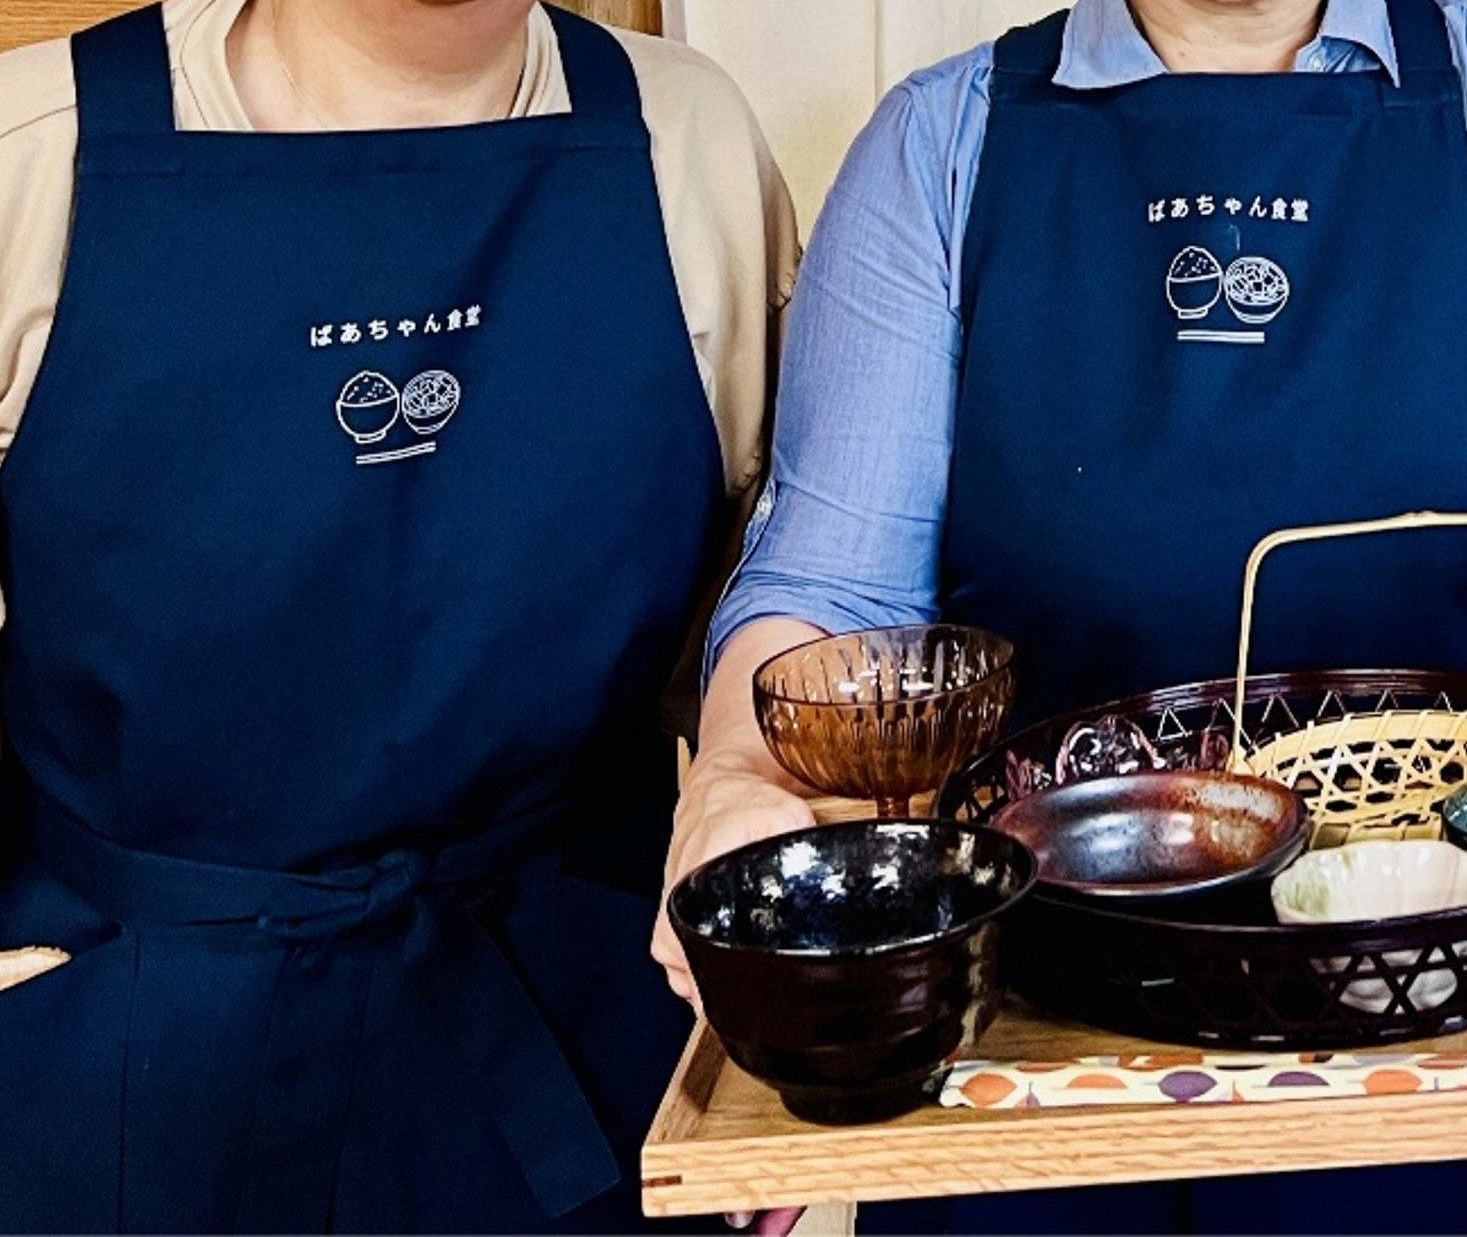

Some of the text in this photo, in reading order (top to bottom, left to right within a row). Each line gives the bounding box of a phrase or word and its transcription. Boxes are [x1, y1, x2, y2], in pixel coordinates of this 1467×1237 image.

[1148, 194, 1309, 222] ばあちゃん食堂
[311, 305, 481, 347] ばあちゃん食堂
